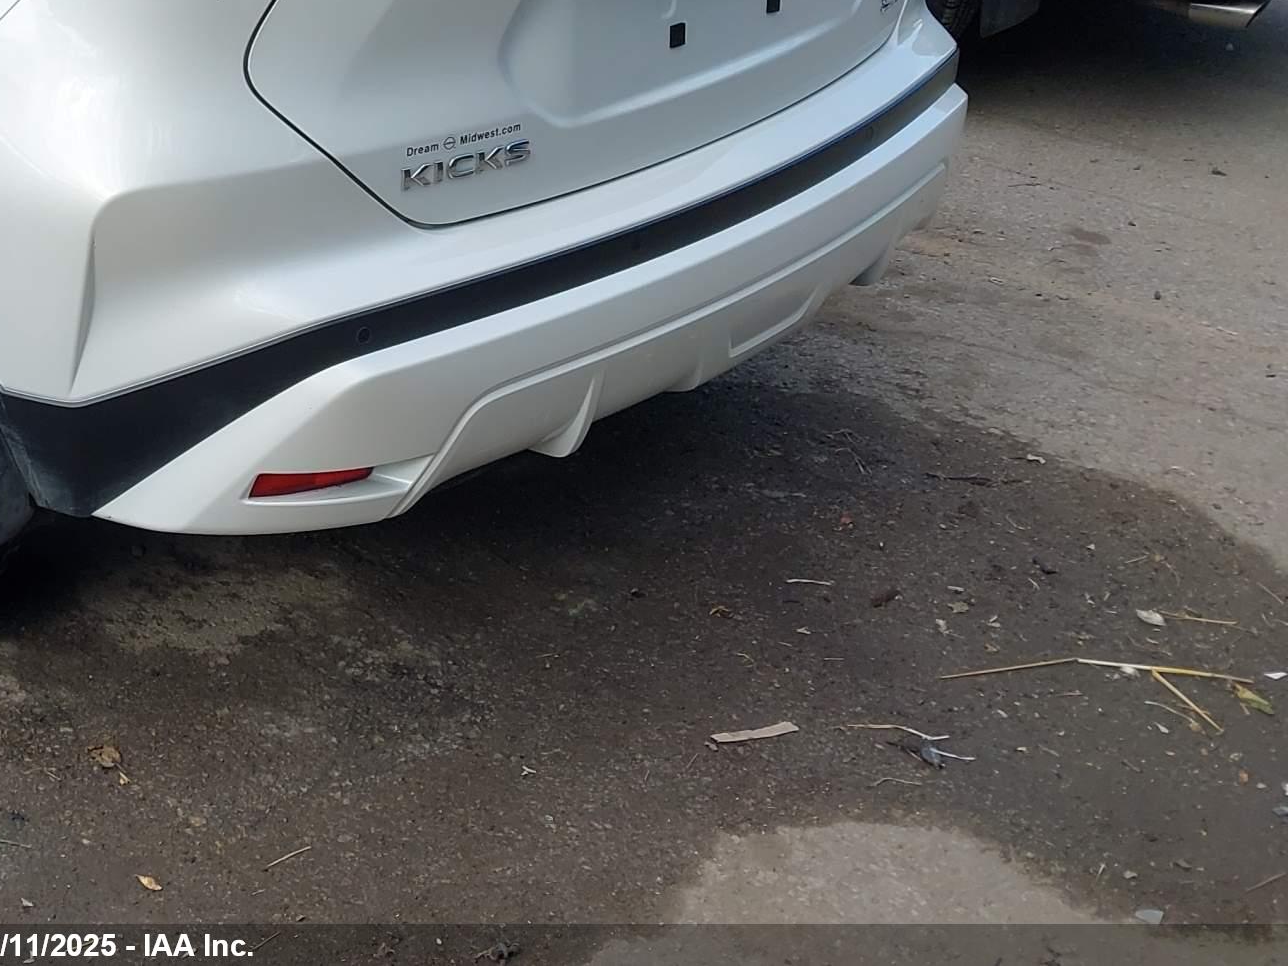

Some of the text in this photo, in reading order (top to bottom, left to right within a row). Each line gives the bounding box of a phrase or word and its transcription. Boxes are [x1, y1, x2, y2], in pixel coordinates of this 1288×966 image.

[406, 122, 522, 157] Dream Midwest.com
[401, 138, 532, 192] KICKS
